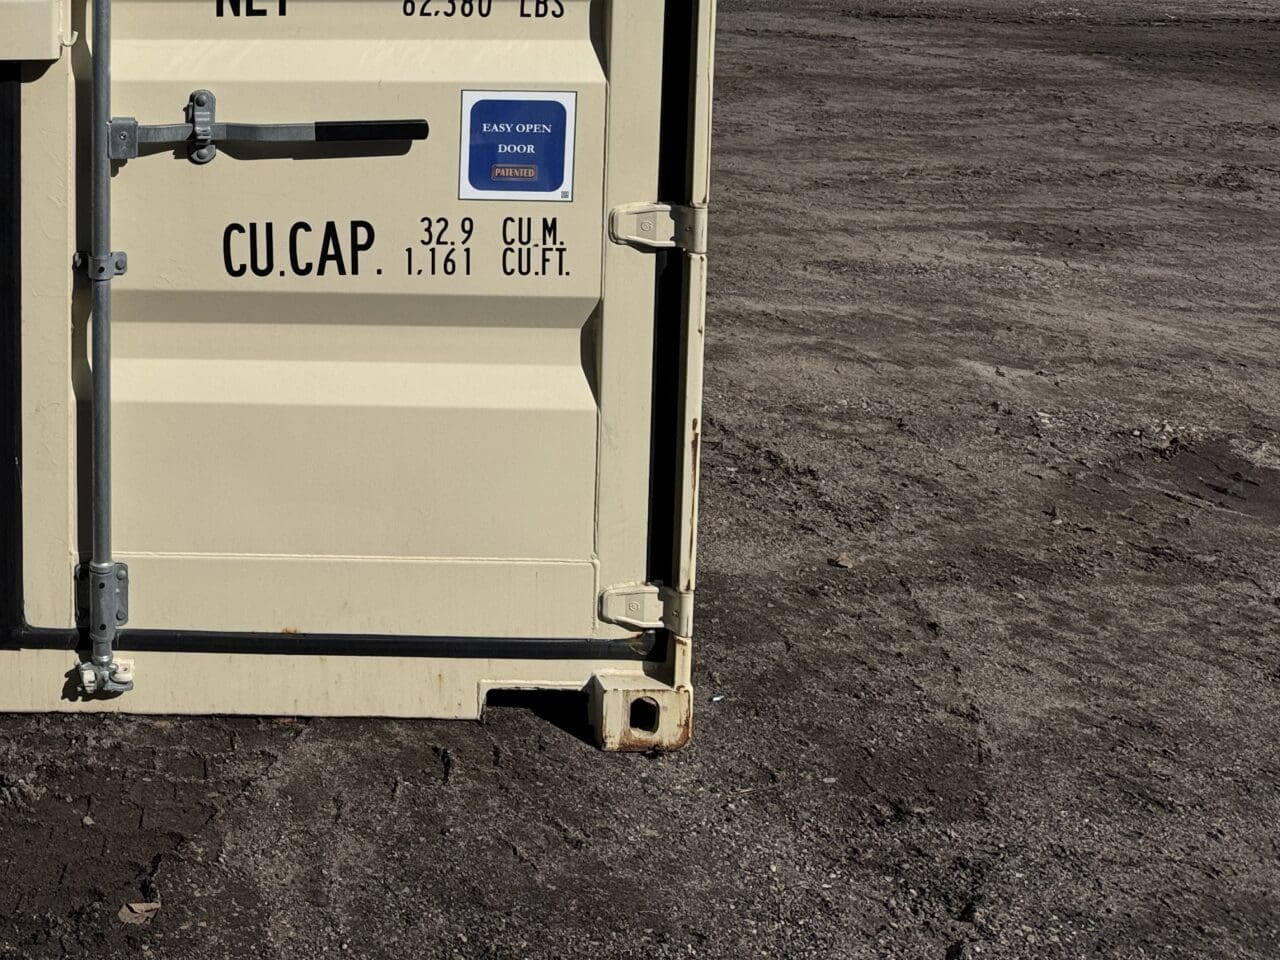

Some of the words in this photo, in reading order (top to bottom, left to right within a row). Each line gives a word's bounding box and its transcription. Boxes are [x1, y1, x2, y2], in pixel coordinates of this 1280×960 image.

[482, 123, 513, 133] EASY
[515, 123, 552, 133] OPEN
[497, 144, 535, 154] DOOR
[495, 167, 535, 178] PATENTED
[223, 220, 382, 278] CU.CAP.
[420, 216, 474, 246] 32.9
[502, 216, 564, 247] CU.M.
[405, 247, 471, 276] 1,161
[502, 247, 570, 276] CU.FT.
